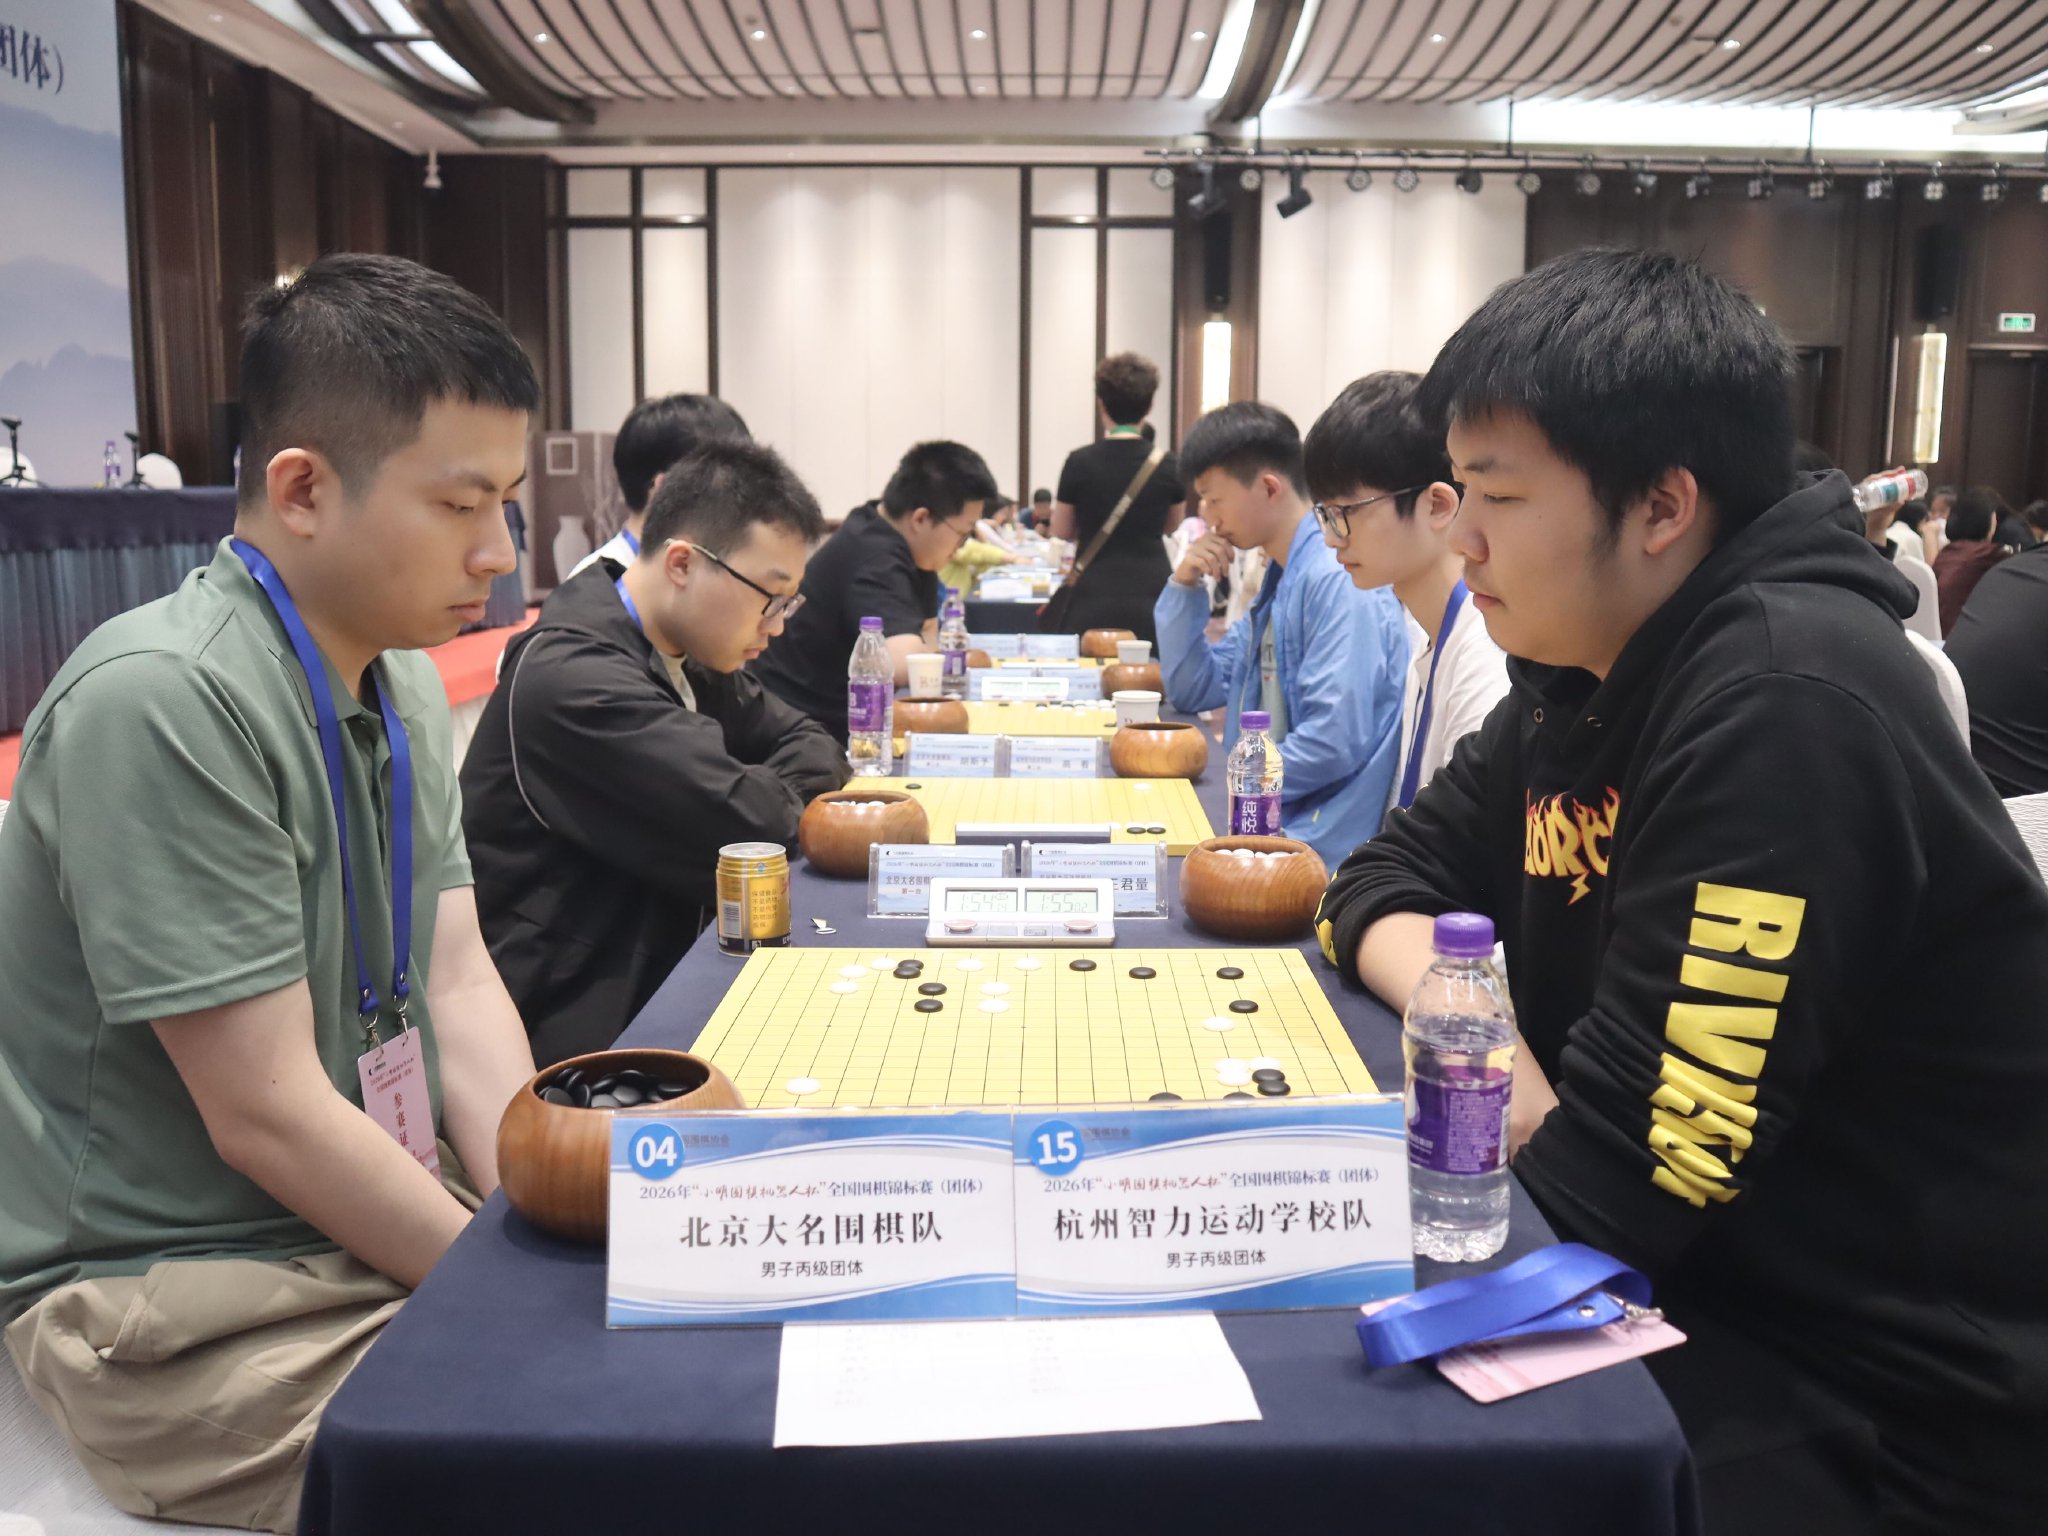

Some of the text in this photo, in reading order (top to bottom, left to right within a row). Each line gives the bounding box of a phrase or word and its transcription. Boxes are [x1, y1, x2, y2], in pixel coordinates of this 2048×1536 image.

[1241, 800, 1257, 833] 纯悦
[635, 1135, 677, 1168] 04
[1037, 1131, 1077, 1165] 15
[680, 1211, 944, 1249] 北京大名围棋队
[1054, 1198, 1373, 1242] 杭州智力运动学校队
[760, 1260, 864, 1279] 男子丙级团体
[1166, 1249, 1267, 1269] 男子丙级团体
